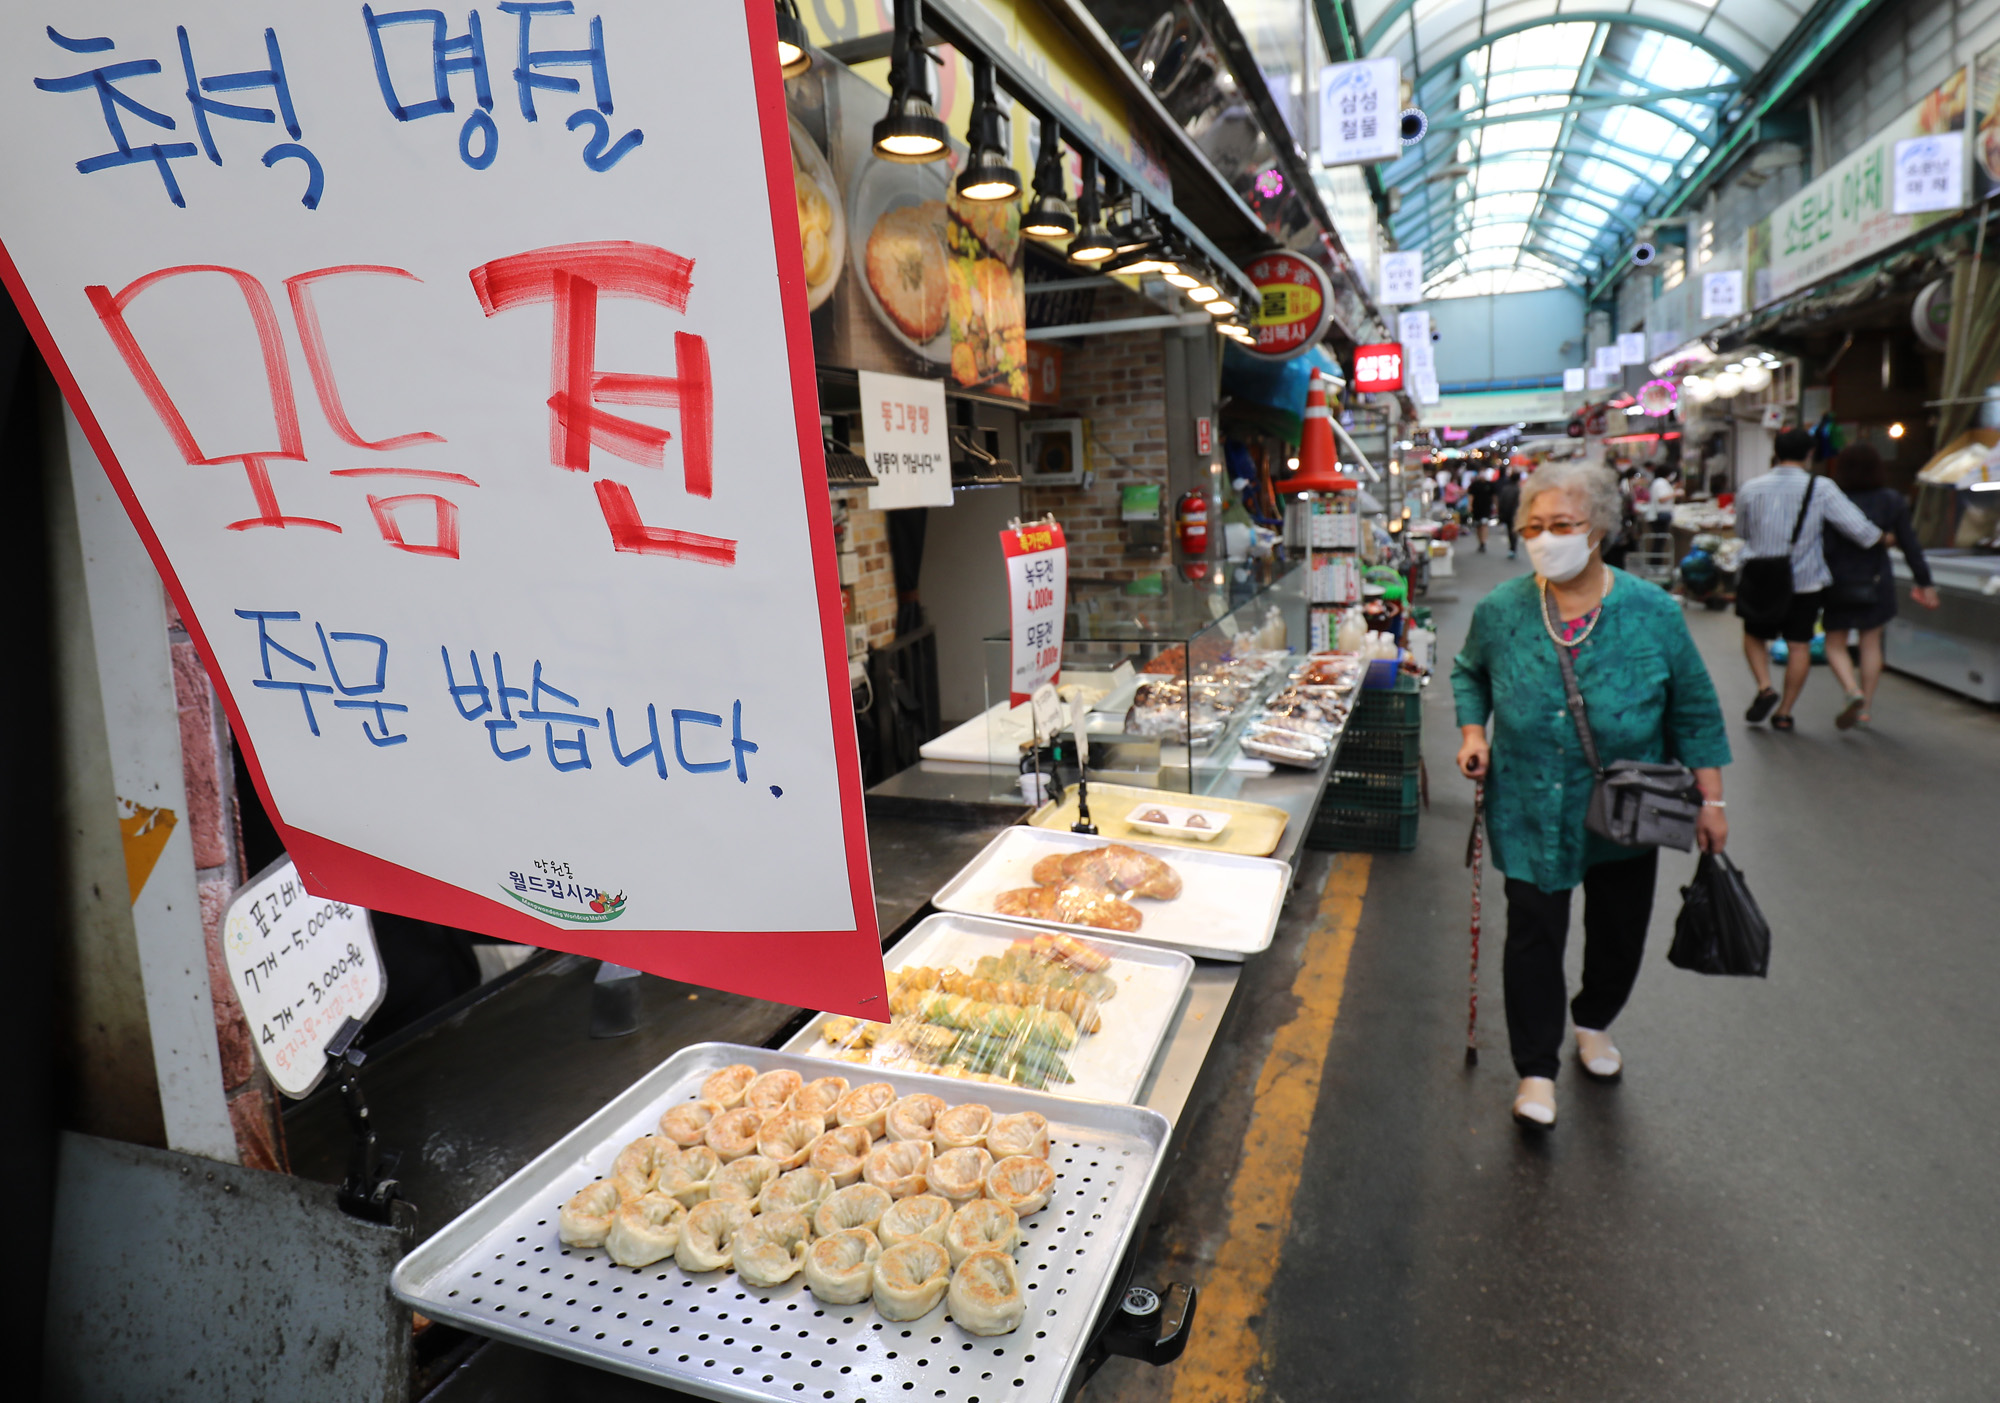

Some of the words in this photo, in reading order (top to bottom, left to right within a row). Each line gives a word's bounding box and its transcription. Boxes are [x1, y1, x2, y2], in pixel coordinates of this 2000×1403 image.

[33, 24, 326, 211] 추석
[361, 1, 645, 172] 명절
[1784, 181, 1834, 256] 소문난
[1257, 323, 1307, 345] 쇠복사
[1355, 354, 1401, 383] 생닭
[84, 263, 481, 561] 모듬
[469, 239, 739, 568] 전
[880, 401, 930, 435] 동그랑땡
[1025, 558, 1054, 588] 녹두전
[1026, 620, 1054, 649] 모듬전
[234, 607, 409, 748] 주문
[441, 644, 784, 799] 받습니다.
[533, 859, 574, 879] 망원동
[521, 898, 564, 918] Mangwondong
